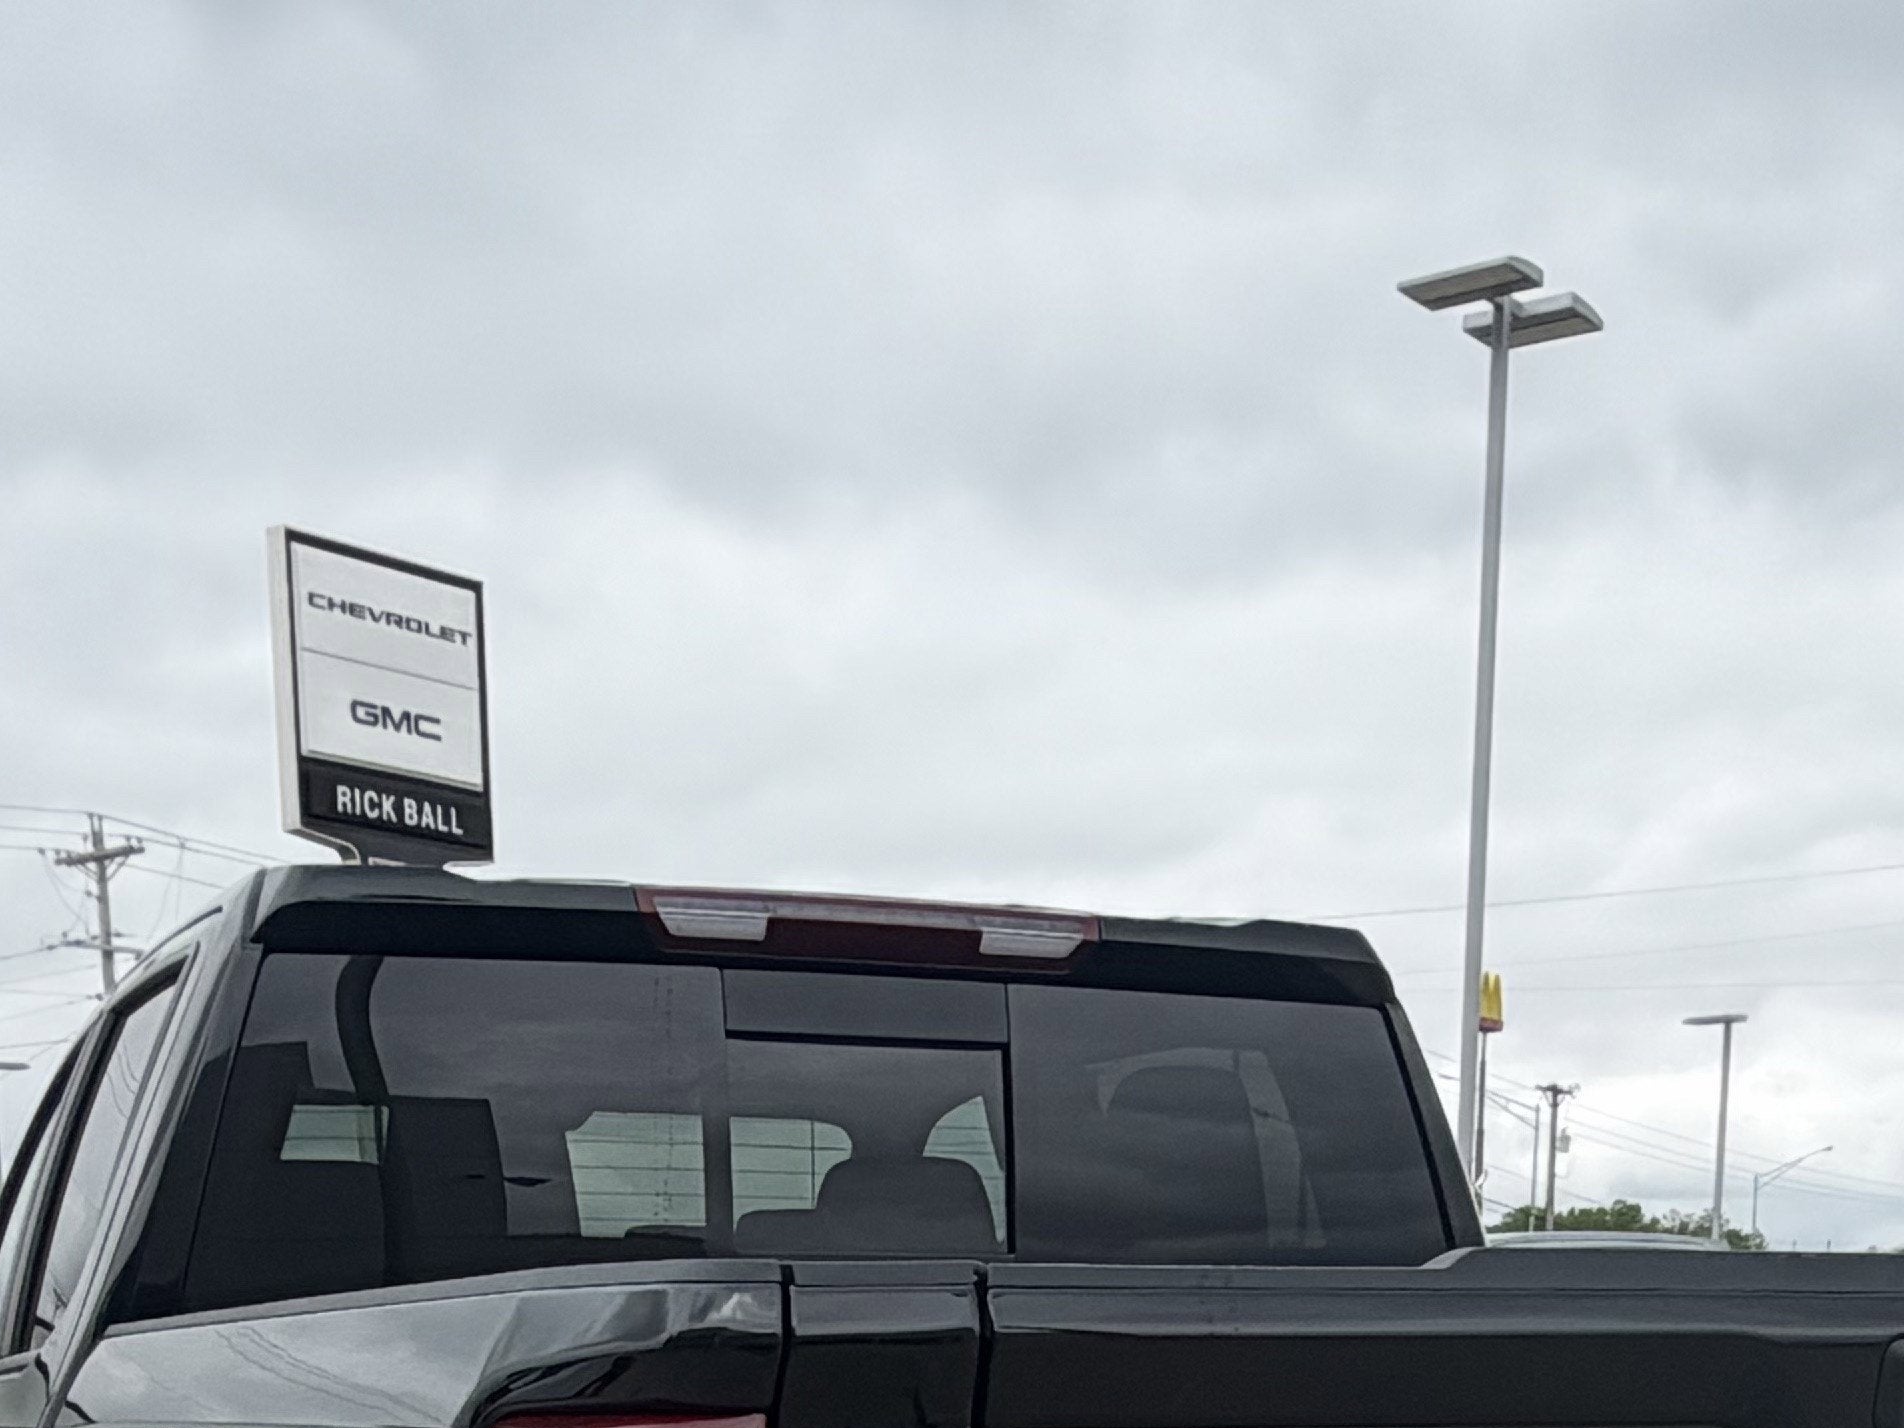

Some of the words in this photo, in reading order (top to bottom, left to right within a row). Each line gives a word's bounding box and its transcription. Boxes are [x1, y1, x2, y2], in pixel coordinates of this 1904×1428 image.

[307, 591, 472, 646] CHEVROLET
[349, 698, 443, 742] GMC
[335, 783, 398, 824] RICK
[403, 796, 464, 836] BALL
